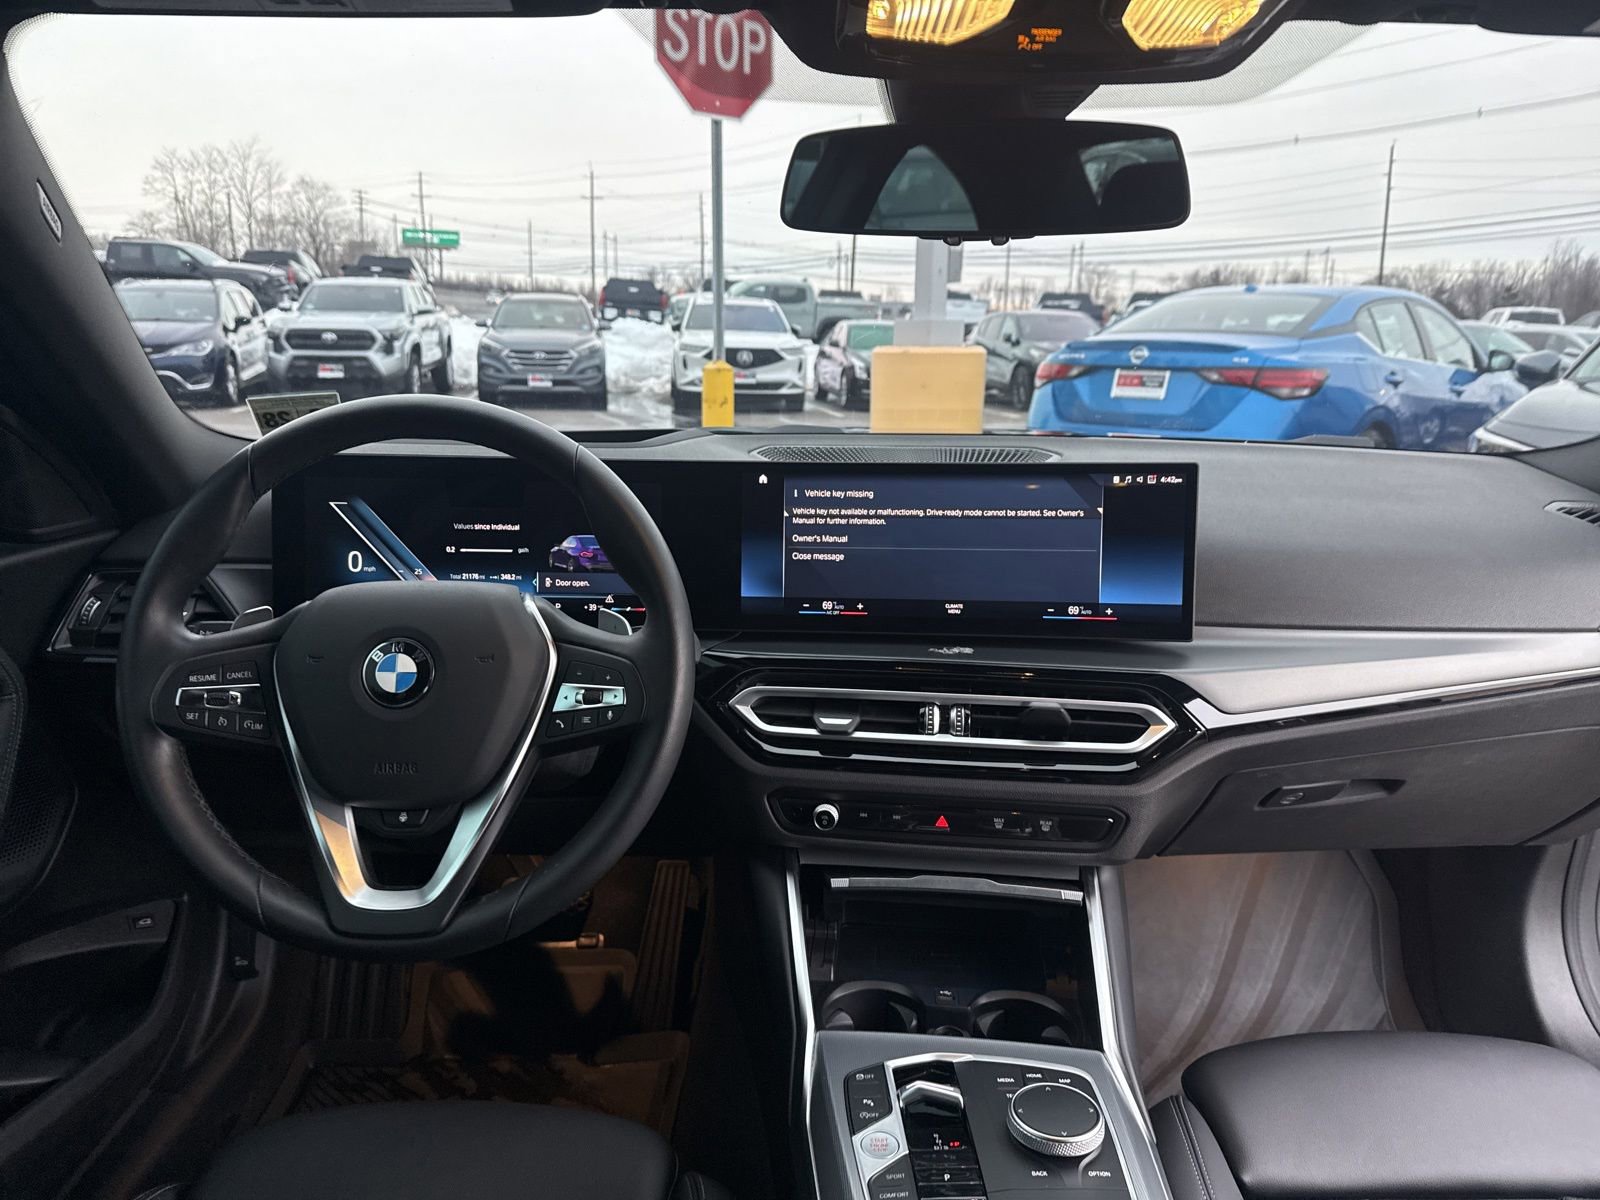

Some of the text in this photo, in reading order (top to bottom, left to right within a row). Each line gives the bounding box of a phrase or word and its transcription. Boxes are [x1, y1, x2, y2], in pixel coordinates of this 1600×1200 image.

[663, 9, 767, 75] STOP
[805, 489, 874, 500] Vehicle key missing
[792, 507, 816, 515] Vehicle
[816, 508, 828, 516] key
[828, 508, 840, 516] not
[840, 508, 868, 516] available
[877, 508, 926, 517] malfunctioning.
[926, 508, 962, 518] Drive-ready
[963, 508, 982, 517] mode
[983, 509, 1007, 517] cannot
[1007, 509, 1016, 517] be
[1017, 509, 1042, 517] started.
[1043, 509, 1056, 517] See
[1057, 509, 1085, 517] Owner's
[792, 517, 887, 526] Manual for further information.
[453, 523, 521, 531] Values since Individual
[792, 534, 848, 543] Owner's Manual
[445, 545, 456, 553] 0.2
[792, 551, 845, 562] Close message
[347, 550, 363, 573] 0
[555, 578, 591, 588] Door open.
[822, 601, 833, 610] 69
[1067, 605, 1080, 615] 69
[371, 642, 427, 663] BMW
[189, 673, 217, 682] RESUME
[226, 671, 253, 680] CANCEL
[186, 712, 199, 720] SET
[943, 1173, 951, 1182] P
[1088, 1170, 1111, 1178] OPTION
[879, 1191, 909, 1199] COMFORT
